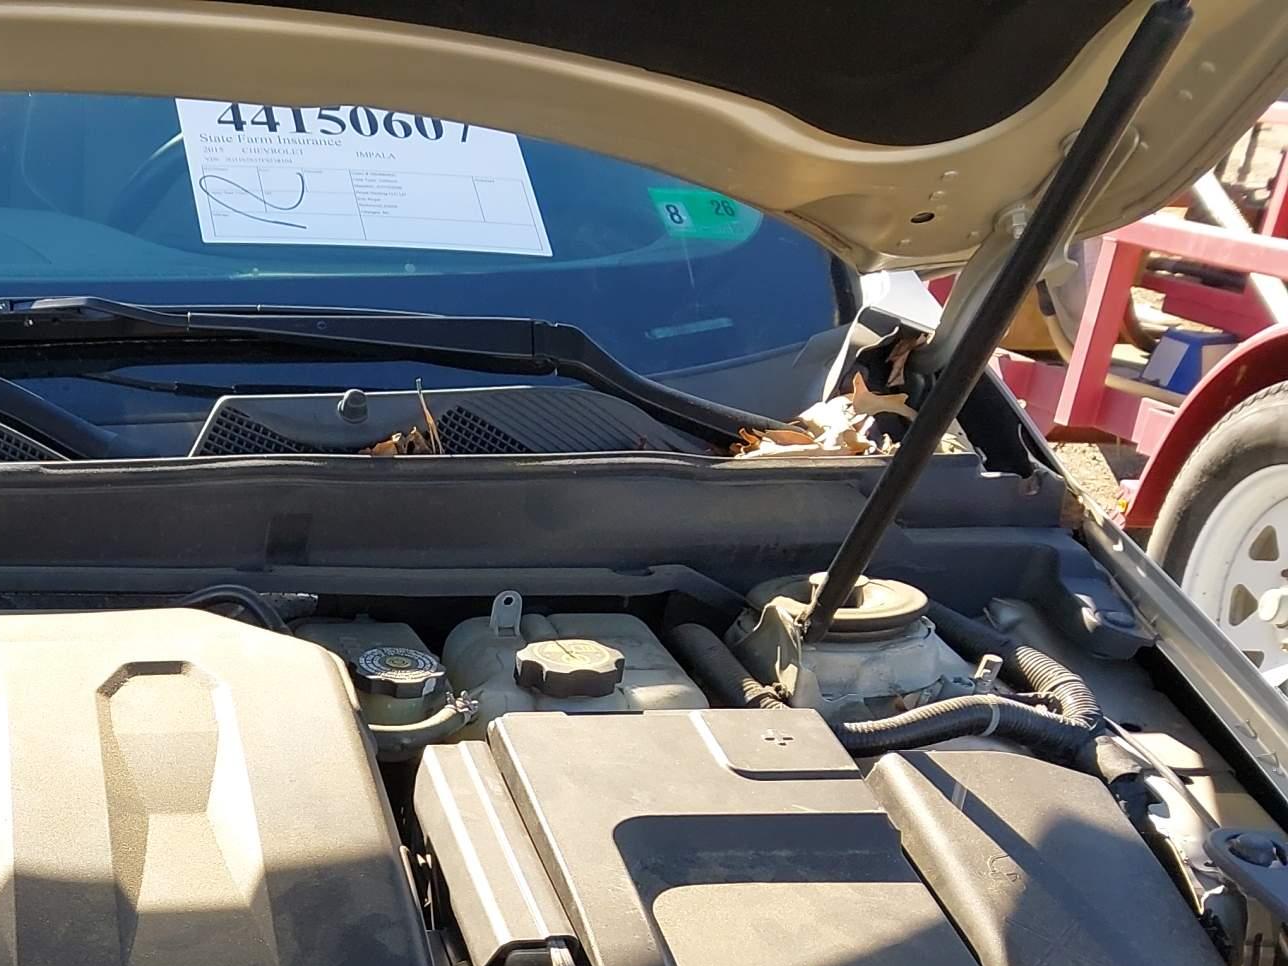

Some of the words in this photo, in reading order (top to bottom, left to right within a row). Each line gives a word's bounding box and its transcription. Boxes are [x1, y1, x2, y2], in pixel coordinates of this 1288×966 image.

[200, 133, 233, 143] State
[237, 134, 272, 145] Farm
[277, 135, 342, 146] Insurance
[356, 151, 396, 160] IMPALA
[665, 204, 684, 225] 8
[710, 199, 736, 217] 26
